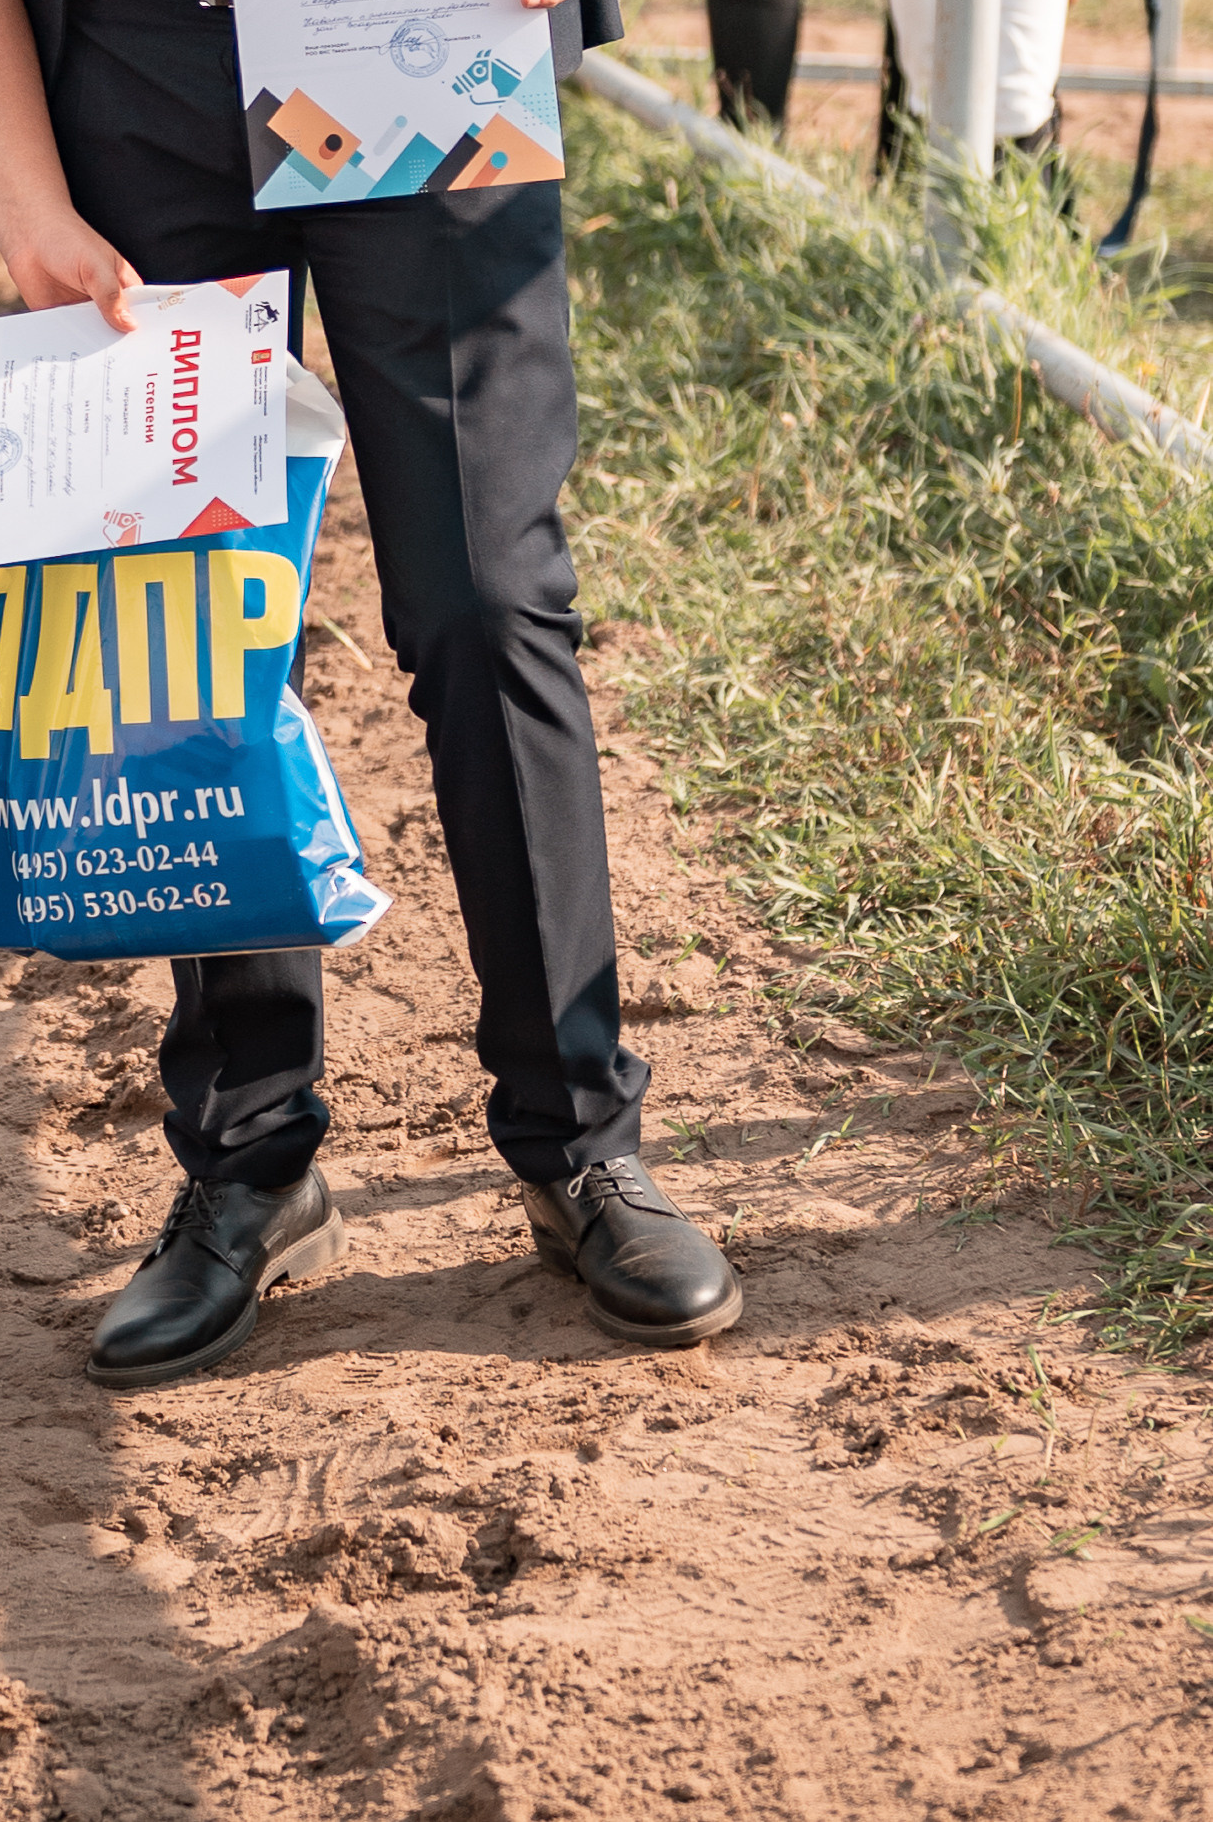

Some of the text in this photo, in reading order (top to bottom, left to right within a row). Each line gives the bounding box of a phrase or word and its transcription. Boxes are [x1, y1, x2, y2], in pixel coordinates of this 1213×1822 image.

[145, 382, 156, 444] степени
[171, 329, 202, 486] ДИПЛОМ
[12, 840, 219, 881] (495) 623-02-44
[16, 882, 231, 924] (495) 530-62-62
